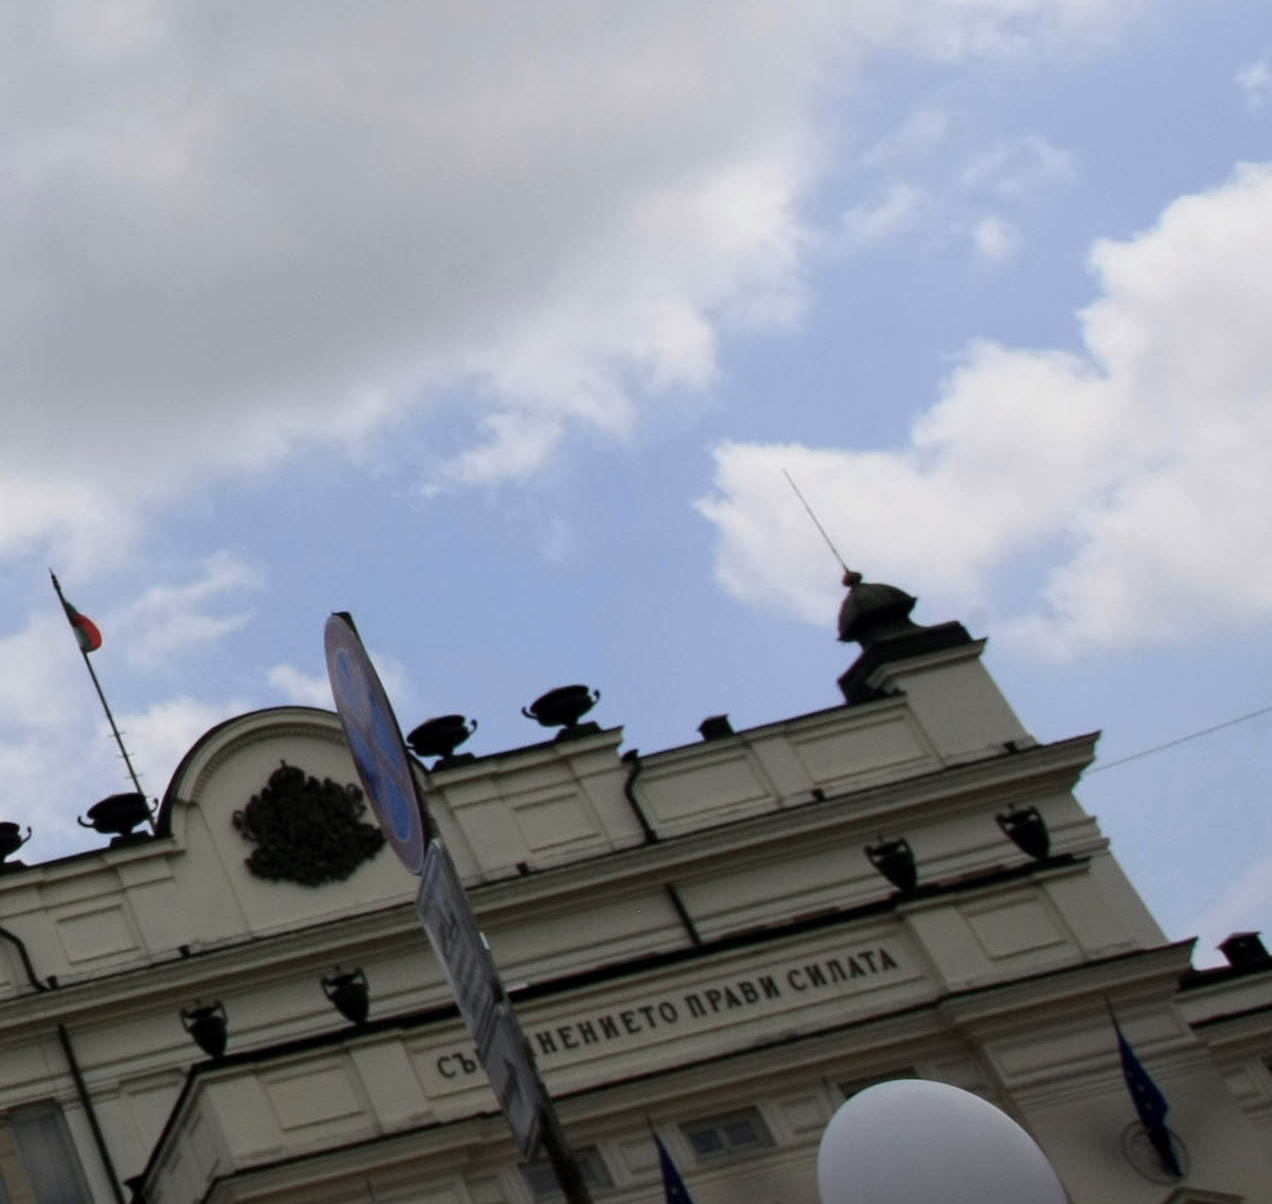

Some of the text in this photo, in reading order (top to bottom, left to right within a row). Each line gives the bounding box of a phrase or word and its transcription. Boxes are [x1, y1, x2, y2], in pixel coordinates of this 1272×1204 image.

[437, 947, 898, 1079] СЪНЕНИЕТО ПРАВИ СИЛАТА
